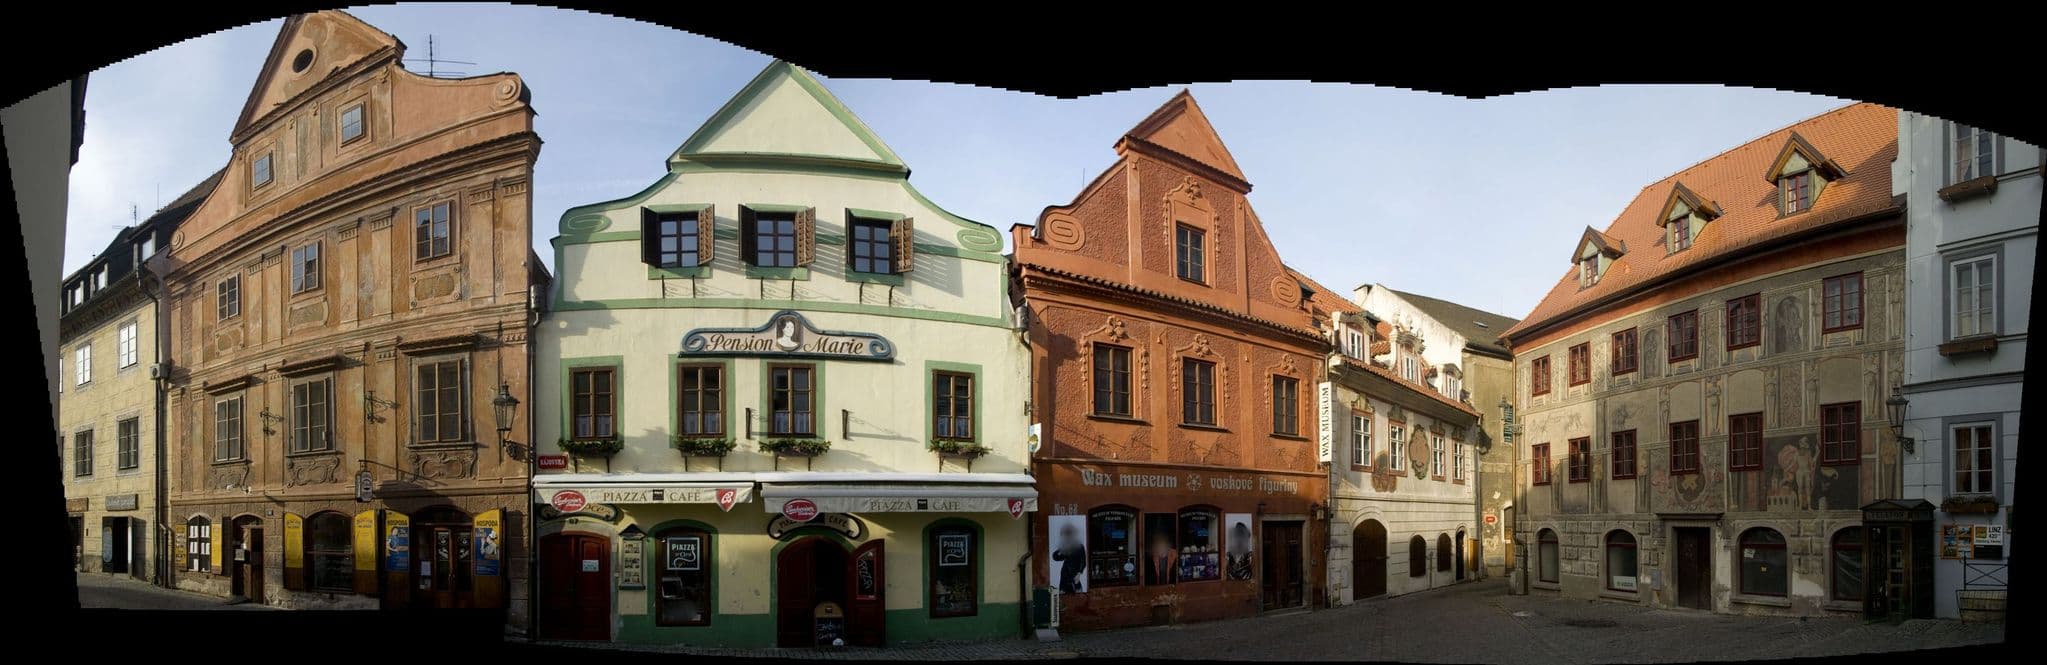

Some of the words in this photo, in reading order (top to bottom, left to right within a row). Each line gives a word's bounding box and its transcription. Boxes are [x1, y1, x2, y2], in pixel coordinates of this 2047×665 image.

[705, 333, 773, 351] Pension
[803, 336, 864, 354] Marie
[1321, 387, 1329, 432] MUSEUM
[1321, 434, 1329, 457] WAX
[1081, 468, 1113, 487] Wax
[1119, 473, 1178, 488] museum
[1210, 475, 1253, 491] voskové
[603, 491, 647, 502] PIAZZA
[870, 501, 912, 511] PIAZZA
